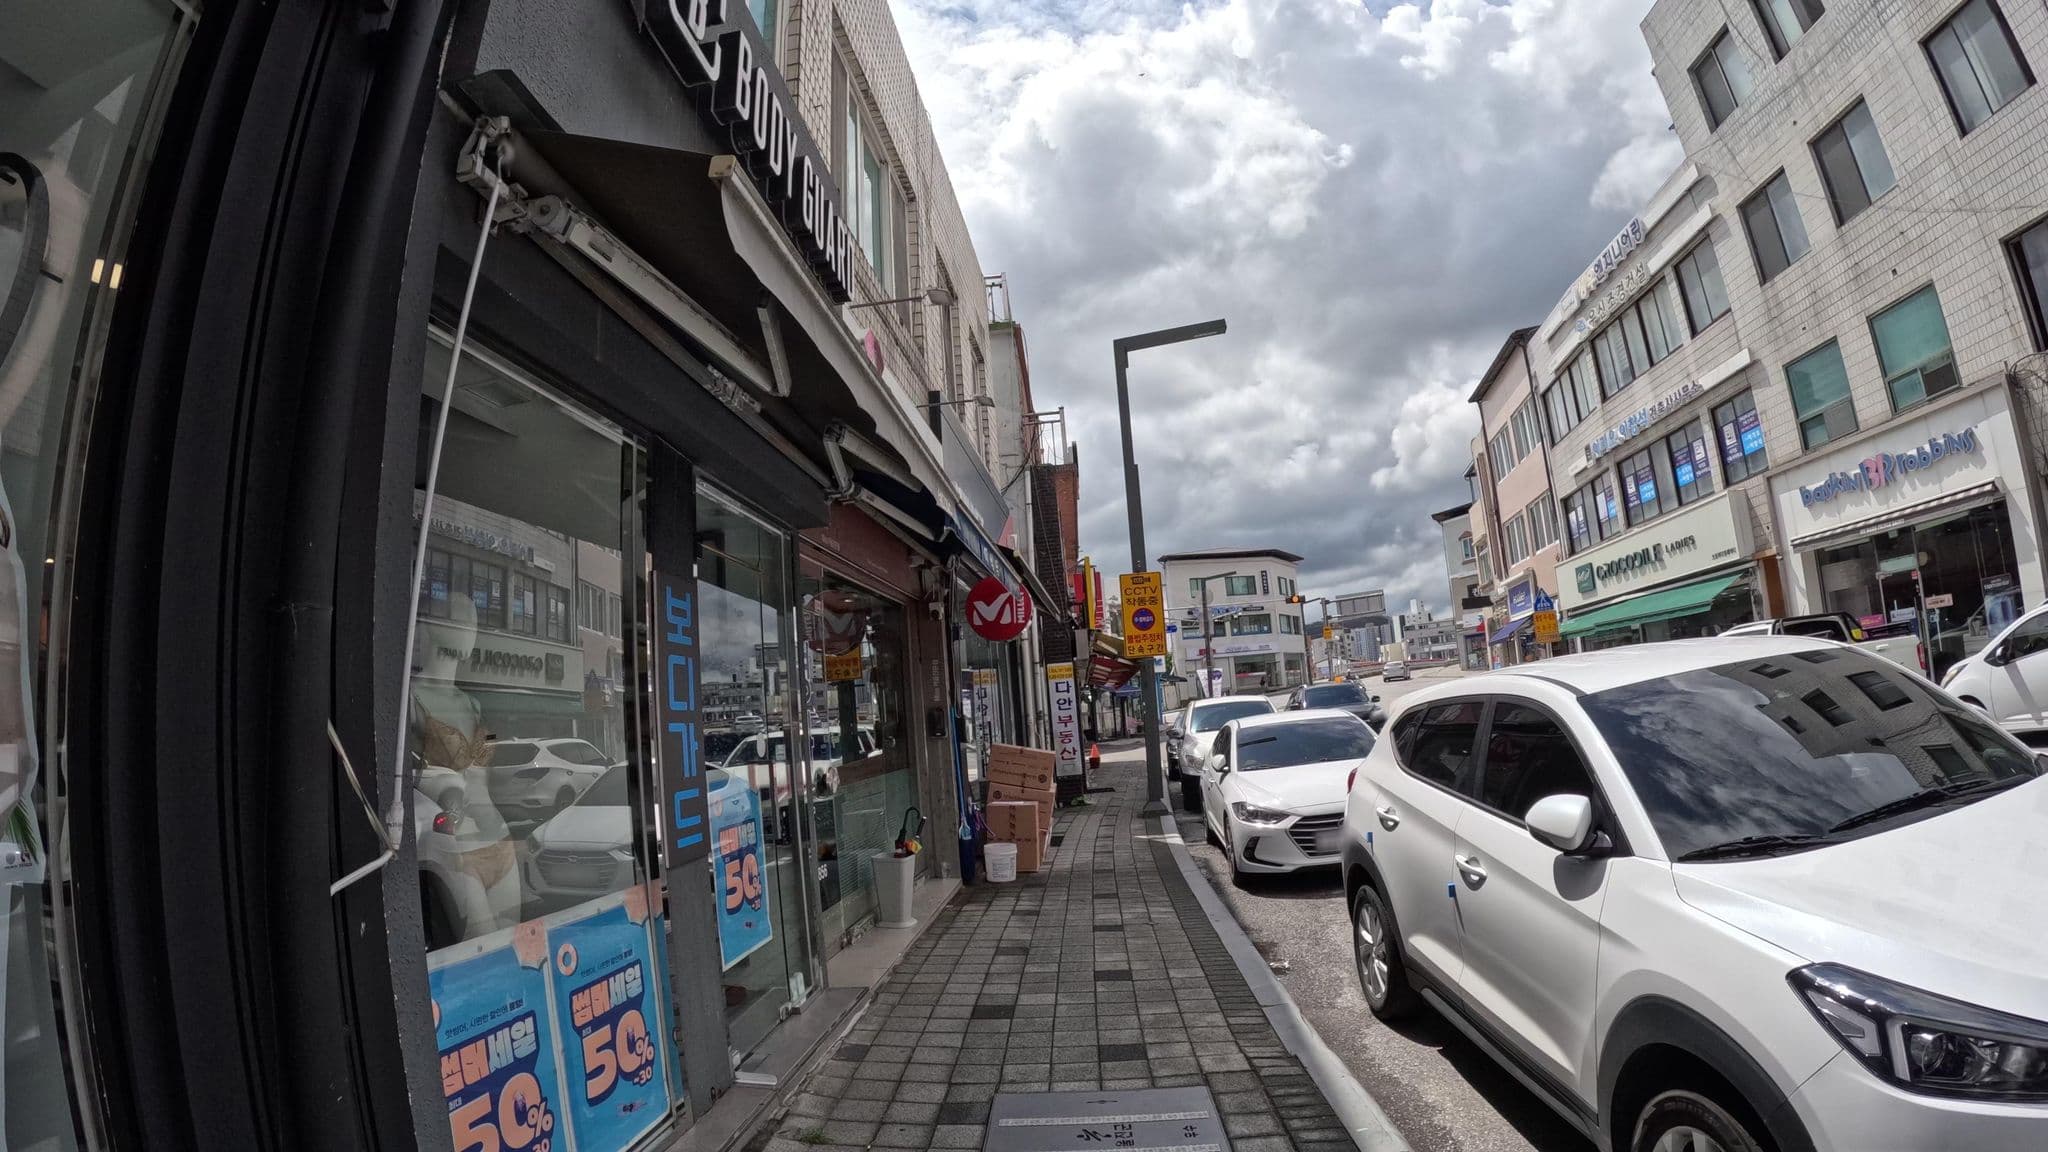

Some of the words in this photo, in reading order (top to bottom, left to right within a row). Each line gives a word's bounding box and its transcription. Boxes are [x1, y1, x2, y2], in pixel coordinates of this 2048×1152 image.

[736, 30, 798, 198] BODY
[802, 155, 856, 303] GUARD
[1596, 543, 1663, 581] CROCODILE
[1665, 535, 1696, 553] LADIES
[1124, 586, 1158, 596] CCTV
[1126, 596, 1159, 607] 작동중
[1127, 633, 1163, 644] 불법주정차
[665, 584, 704, 849] 보디가드
[1055, 681, 1078, 761] 다안부동산
